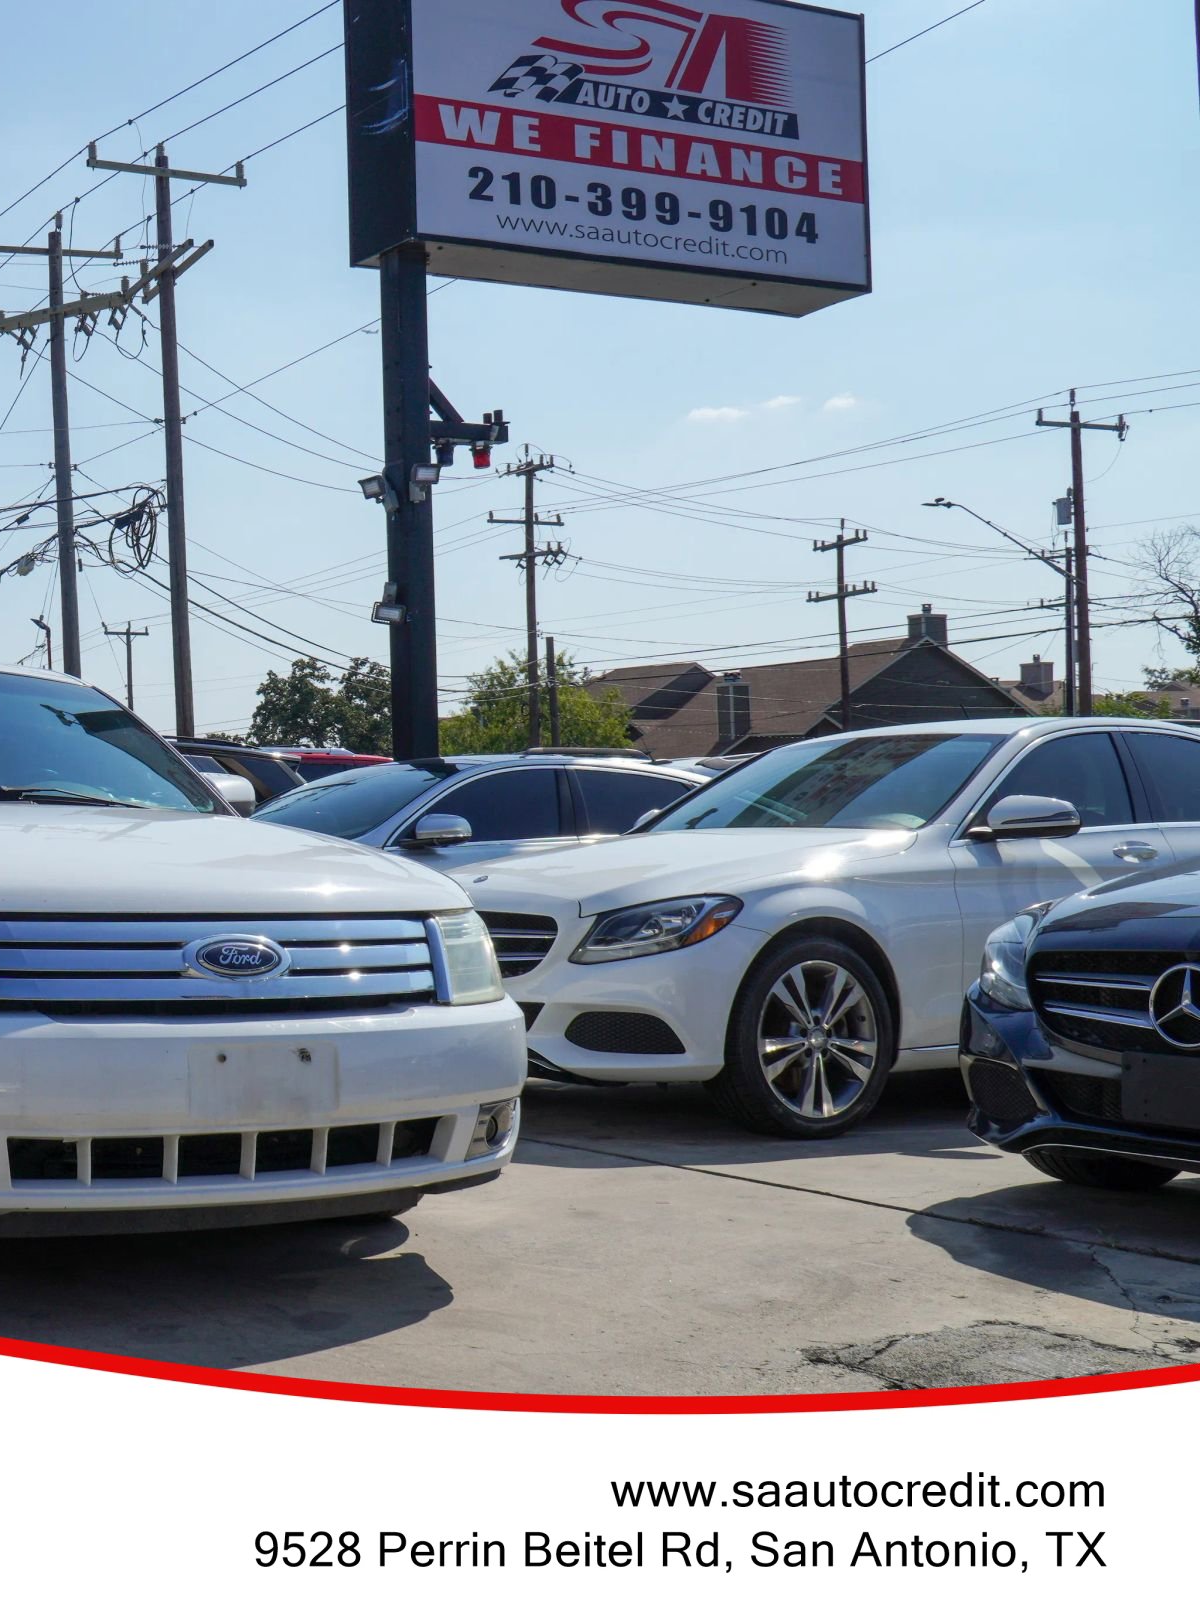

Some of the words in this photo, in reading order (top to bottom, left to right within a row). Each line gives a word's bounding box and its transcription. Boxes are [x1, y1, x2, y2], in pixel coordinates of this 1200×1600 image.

[575, 81, 650, 114] AUTO
[697, 100, 788, 136] CREDIT
[438, 103, 541, 152] WE
[574, 123, 843, 196] FINANCE
[468, 166, 819, 245] 210-399-9104
[496, 214, 788, 265] www.saautocredit.com
[219, 945, 262, 965] Ford
